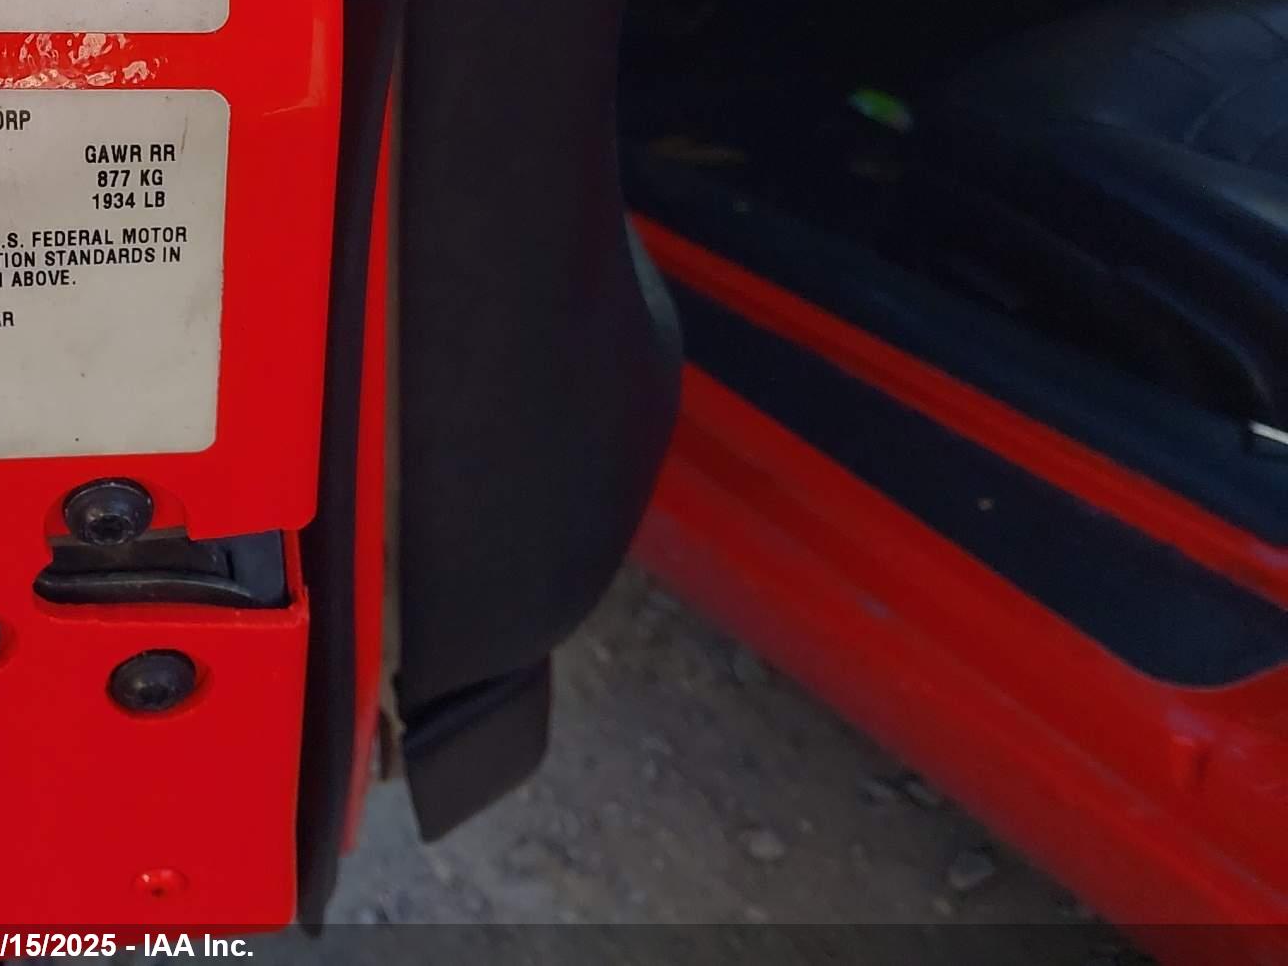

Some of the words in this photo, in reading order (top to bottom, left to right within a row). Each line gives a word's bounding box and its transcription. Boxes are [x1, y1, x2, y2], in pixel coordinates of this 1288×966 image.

[85, 144, 142, 163] GAWR
[149, 144, 176, 162] RR
[97, 170, 130, 188] 877
[139, 169, 163, 187] KG
[92, 192, 136, 210] 1934
[144, 191, 166, 209] LB
[32, 229, 114, 248] FEDERAL
[122, 226, 188, 245] MOTOR
[45, 248, 156, 267] STANDARDS
[162, 246, 181, 263] IN
[11, 269, 76, 288] ABOVE.
